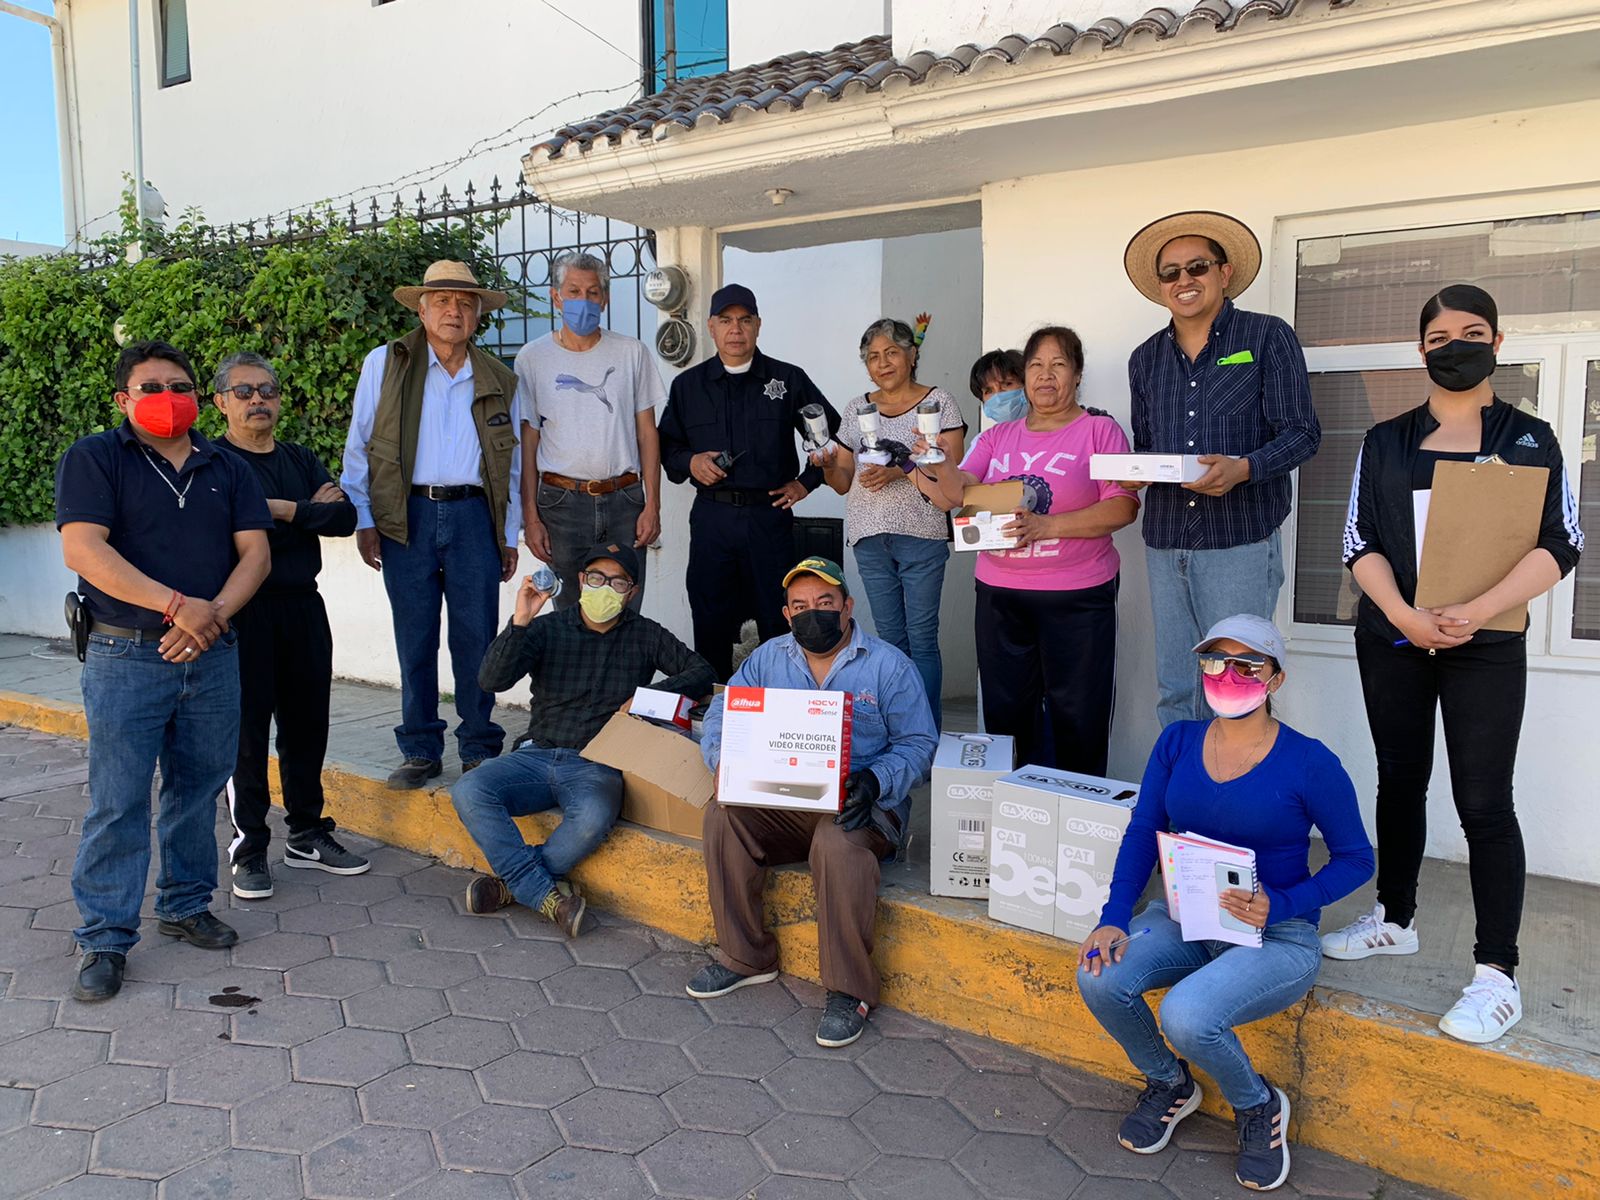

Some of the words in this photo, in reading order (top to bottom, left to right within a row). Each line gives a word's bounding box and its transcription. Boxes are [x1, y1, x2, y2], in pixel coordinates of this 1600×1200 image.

[1515, 440, 1539, 449] adidas
[987, 450, 1077, 479] NYC
[779, 732, 804, 741] HDCVI
[805, 733, 837, 743] DIGITAL
[769, 740, 794, 750] VIDEO
[794, 741, 837, 752] RECORDER
[1020, 774, 1110, 795] SAXON
[1001, 802, 1049, 823] SAXON
[1068, 818, 1120, 840] SAXON
[996, 830, 1022, 845] CAT
[1063, 847, 1091, 862] CAT
